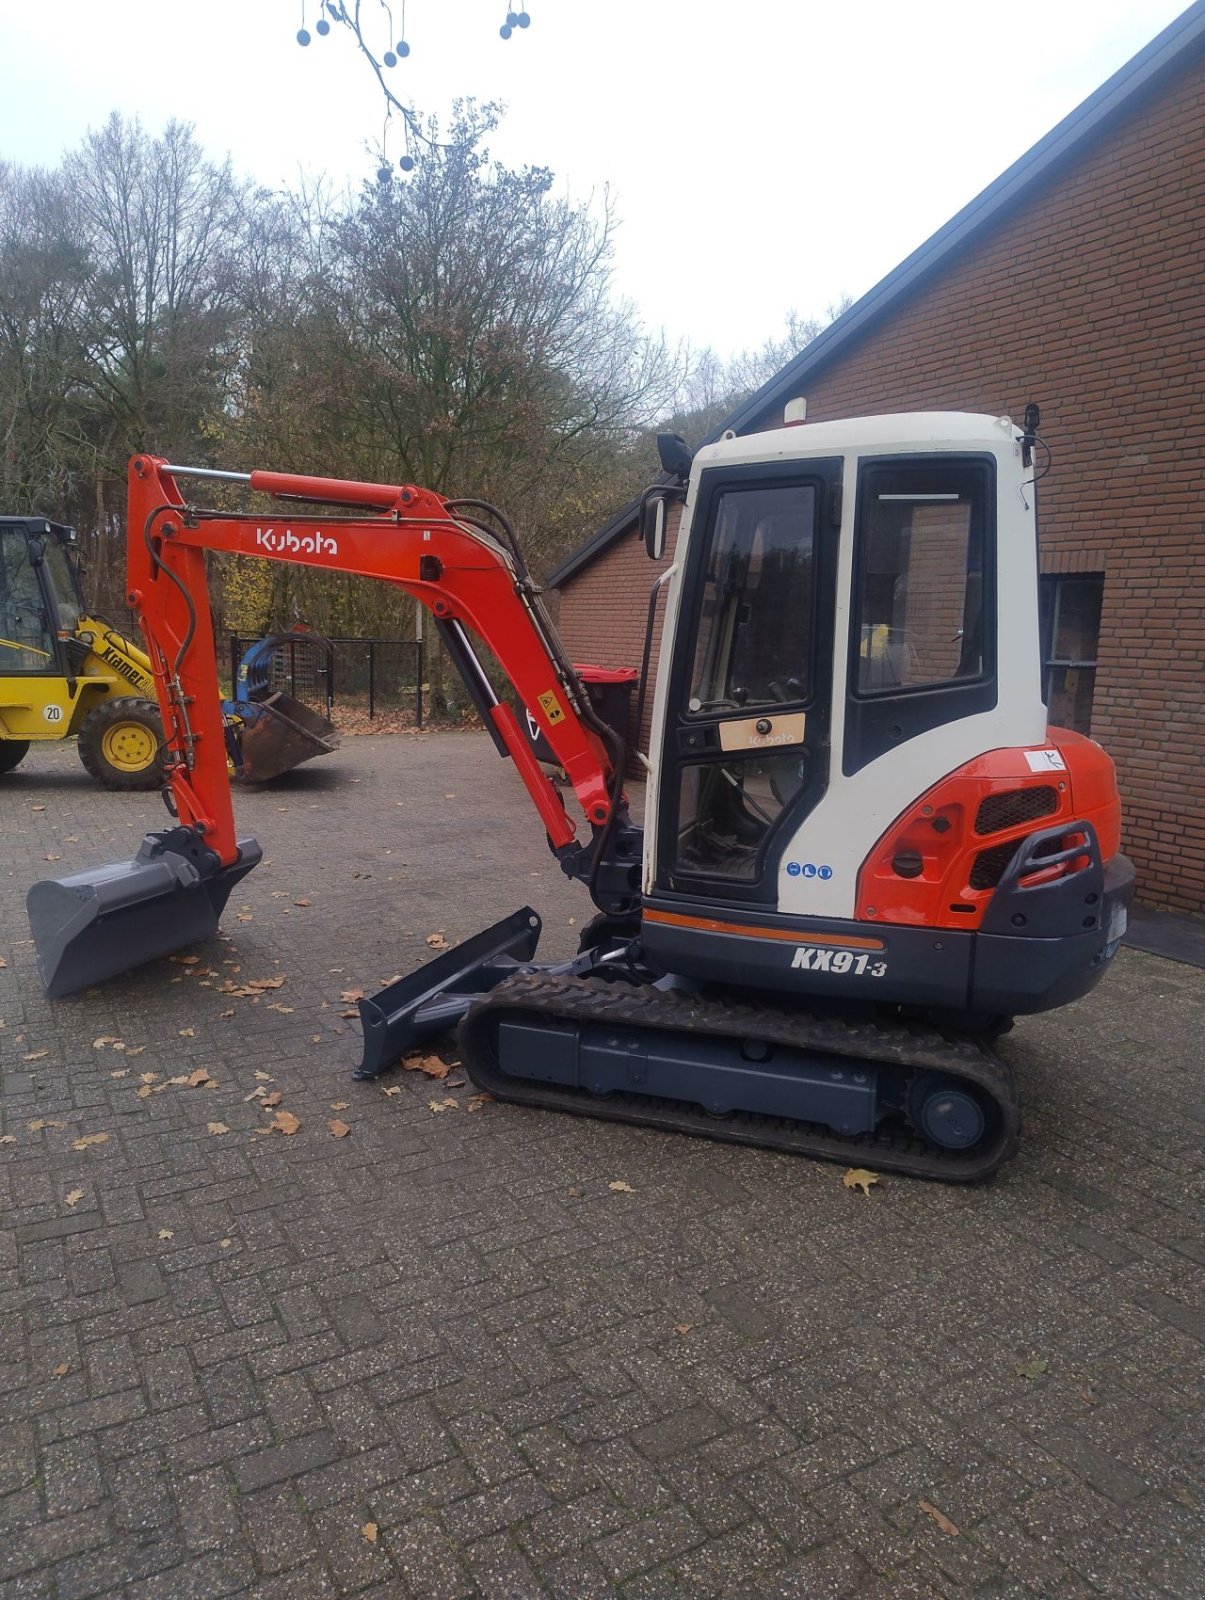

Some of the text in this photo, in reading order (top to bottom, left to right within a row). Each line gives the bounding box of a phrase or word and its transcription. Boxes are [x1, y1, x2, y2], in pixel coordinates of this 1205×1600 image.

[256, 527, 338, 555] Kubota
[100, 645, 145, 691] Kramer
[47, 707, 60, 720] 20
[791, 947, 888, 977] KX91-3
